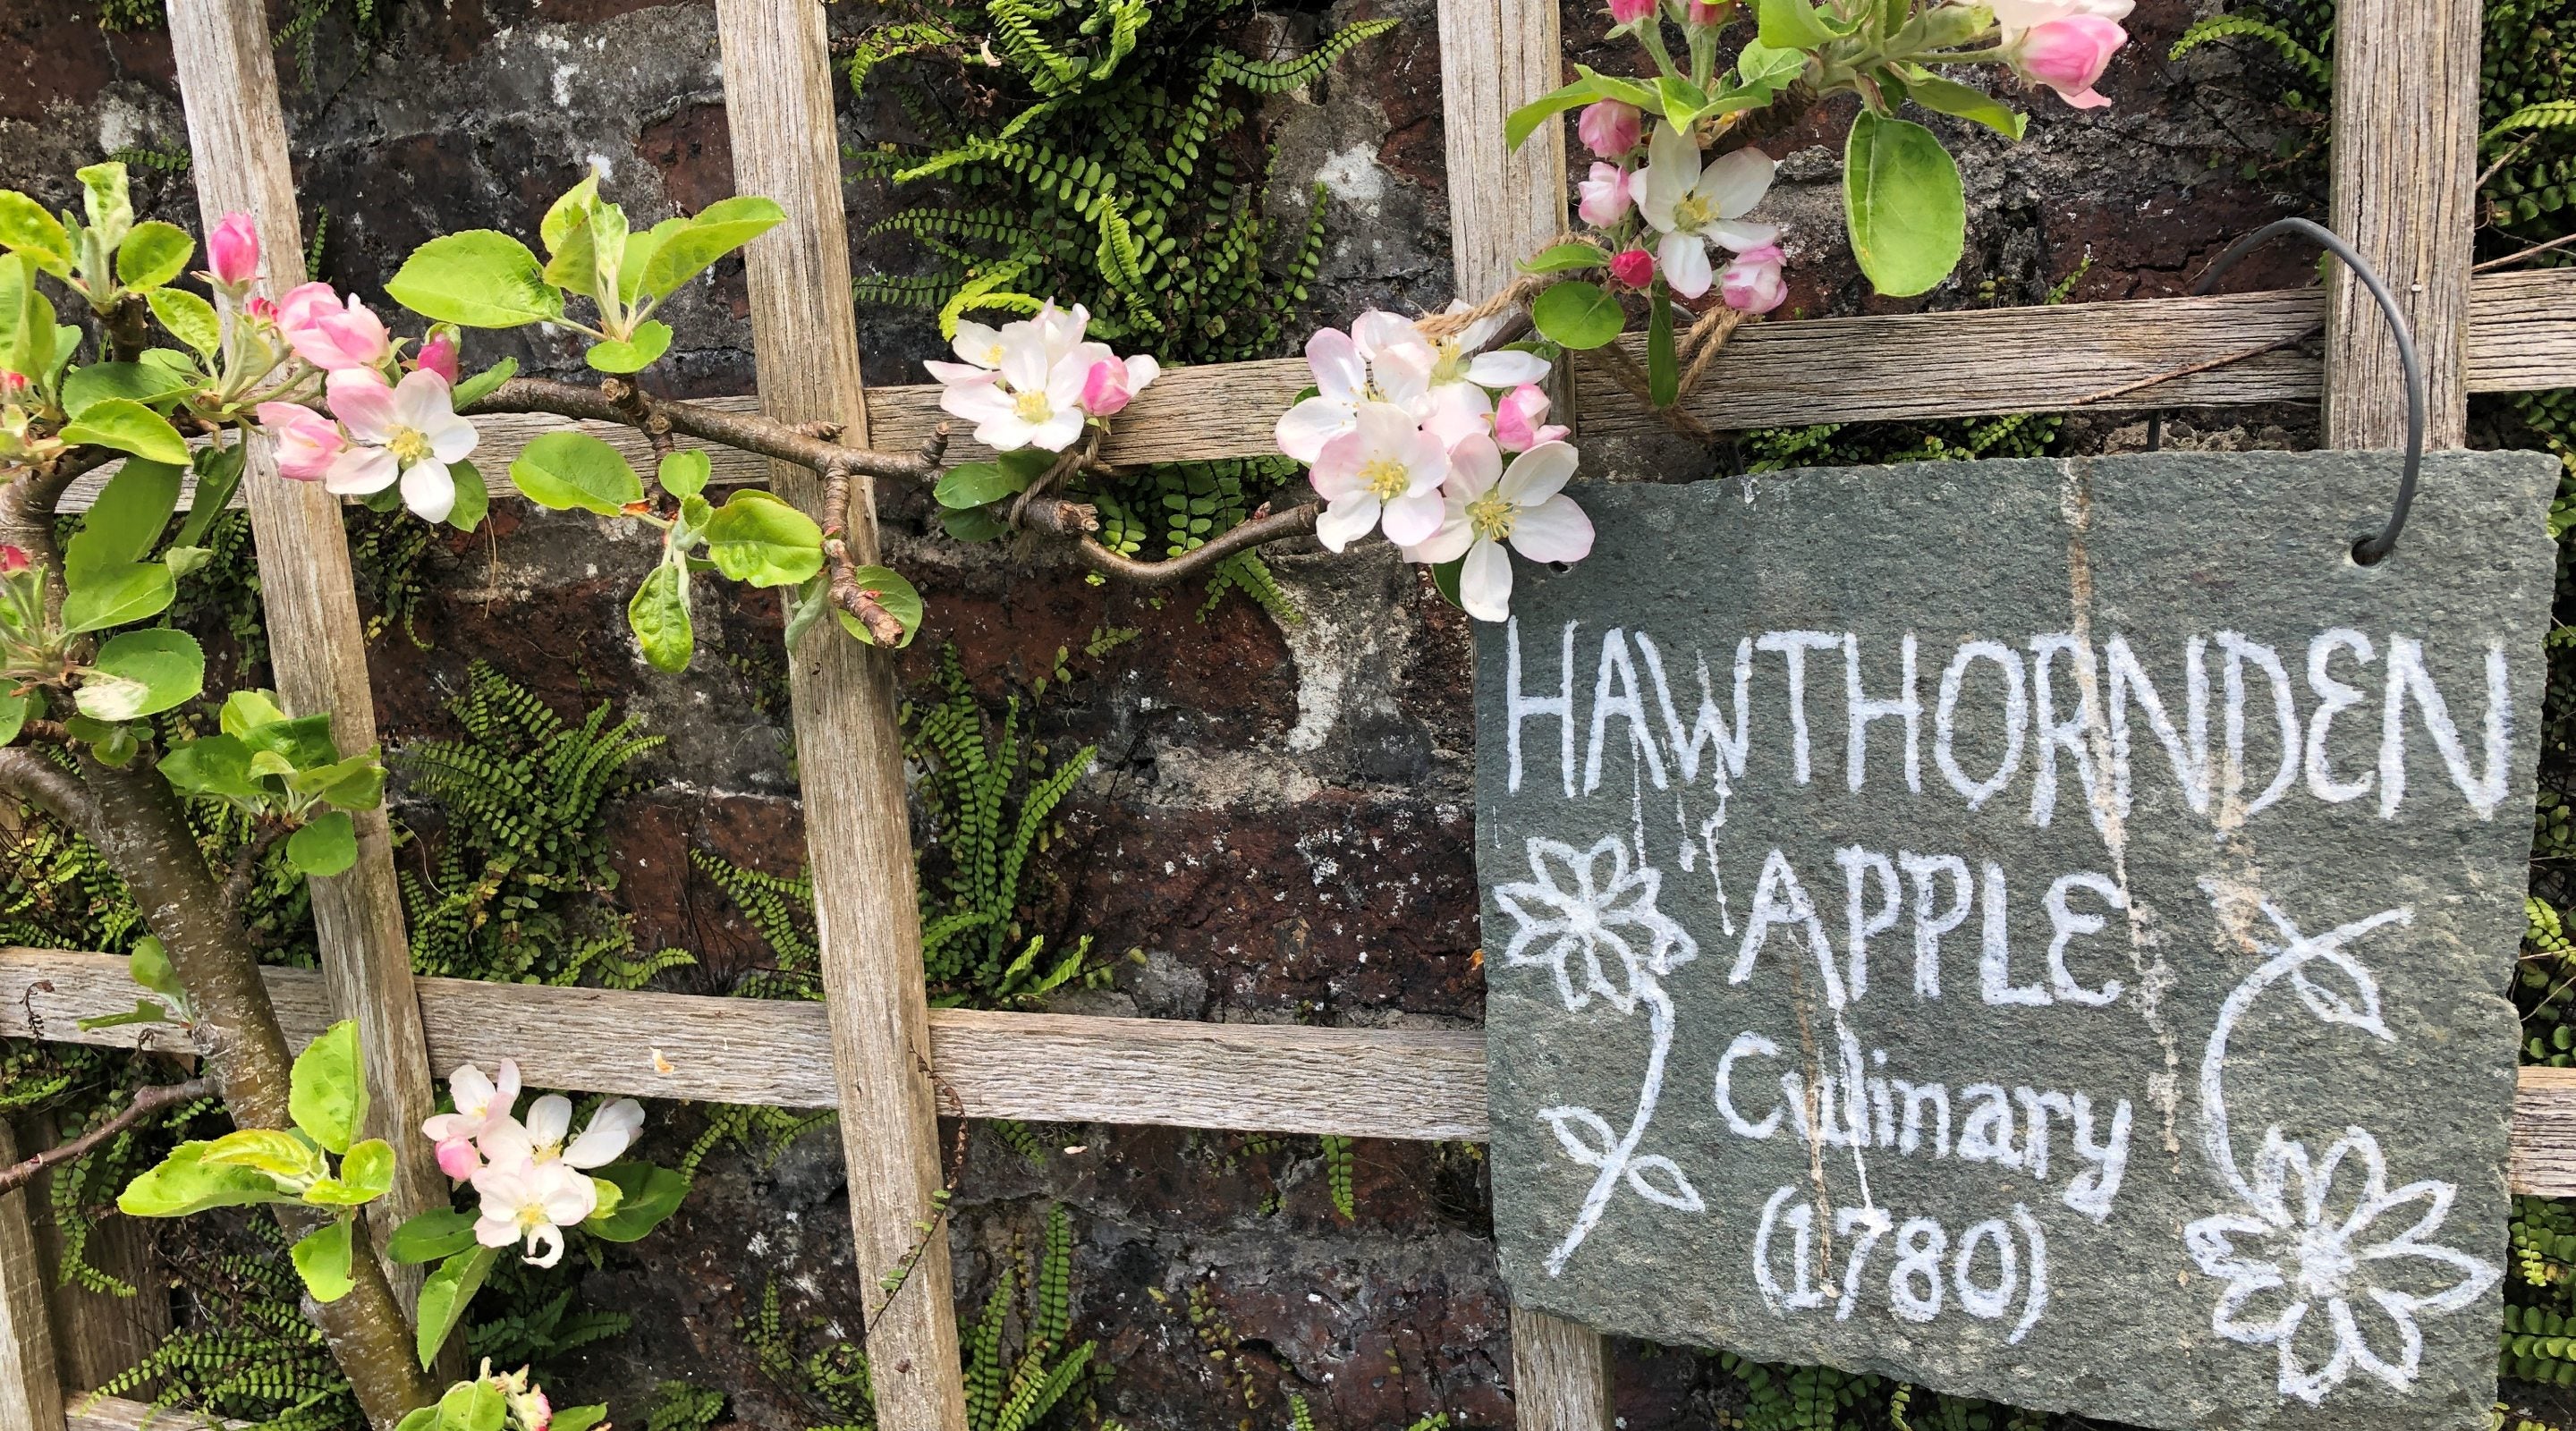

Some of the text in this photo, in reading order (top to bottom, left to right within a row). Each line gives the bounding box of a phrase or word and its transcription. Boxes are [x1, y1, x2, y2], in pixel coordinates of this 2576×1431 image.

[1507, 616, 2508, 827] HAWTHORNDEN
[1728, 845, 2126, 1008] APPLE
[1716, 1031, 2131, 1224] Culinary
[1753, 1186, 2048, 1346] (1780)
